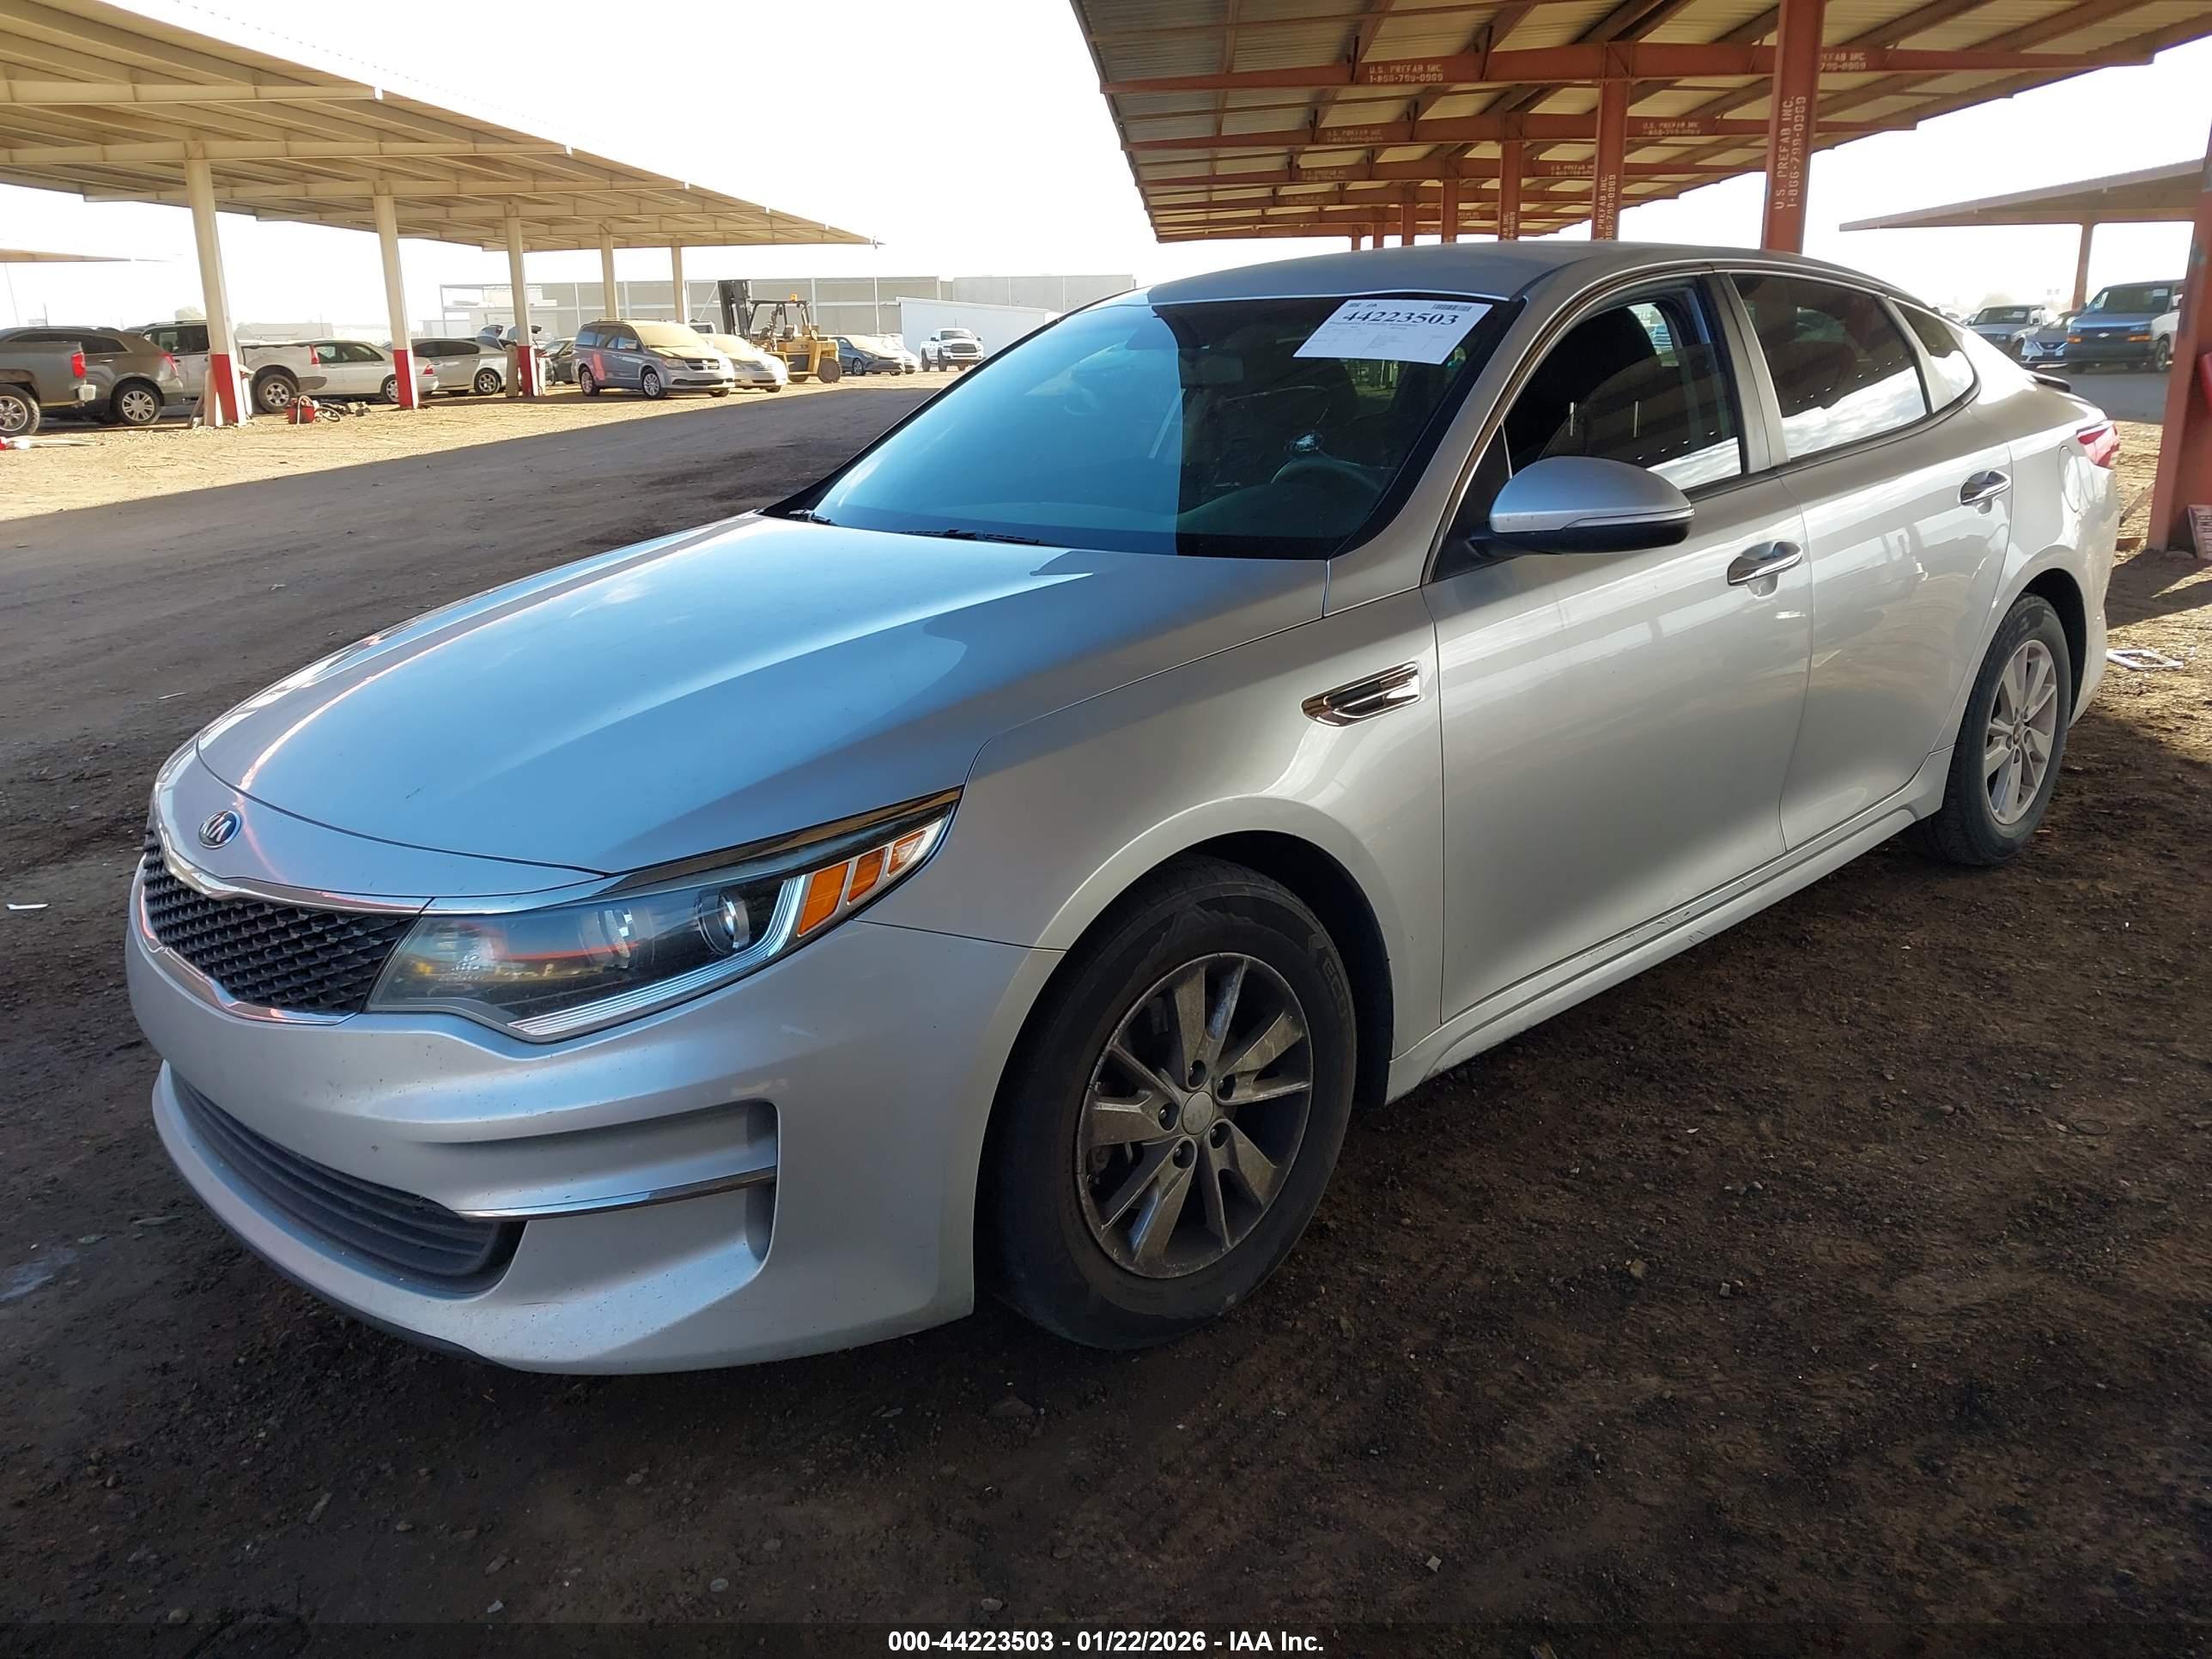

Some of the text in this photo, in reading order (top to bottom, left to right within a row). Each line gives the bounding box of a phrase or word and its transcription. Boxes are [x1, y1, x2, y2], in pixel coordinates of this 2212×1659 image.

[1389, 64, 1424, 74] PREFAB
[1774, 95, 1795, 210] U.S. PREFAB INC.
[1786, 96, 1807, 207] 1-866-799-0969
[1597, 194, 1607, 230] PREFAB
[1342, 310, 1460, 325] 44223503
